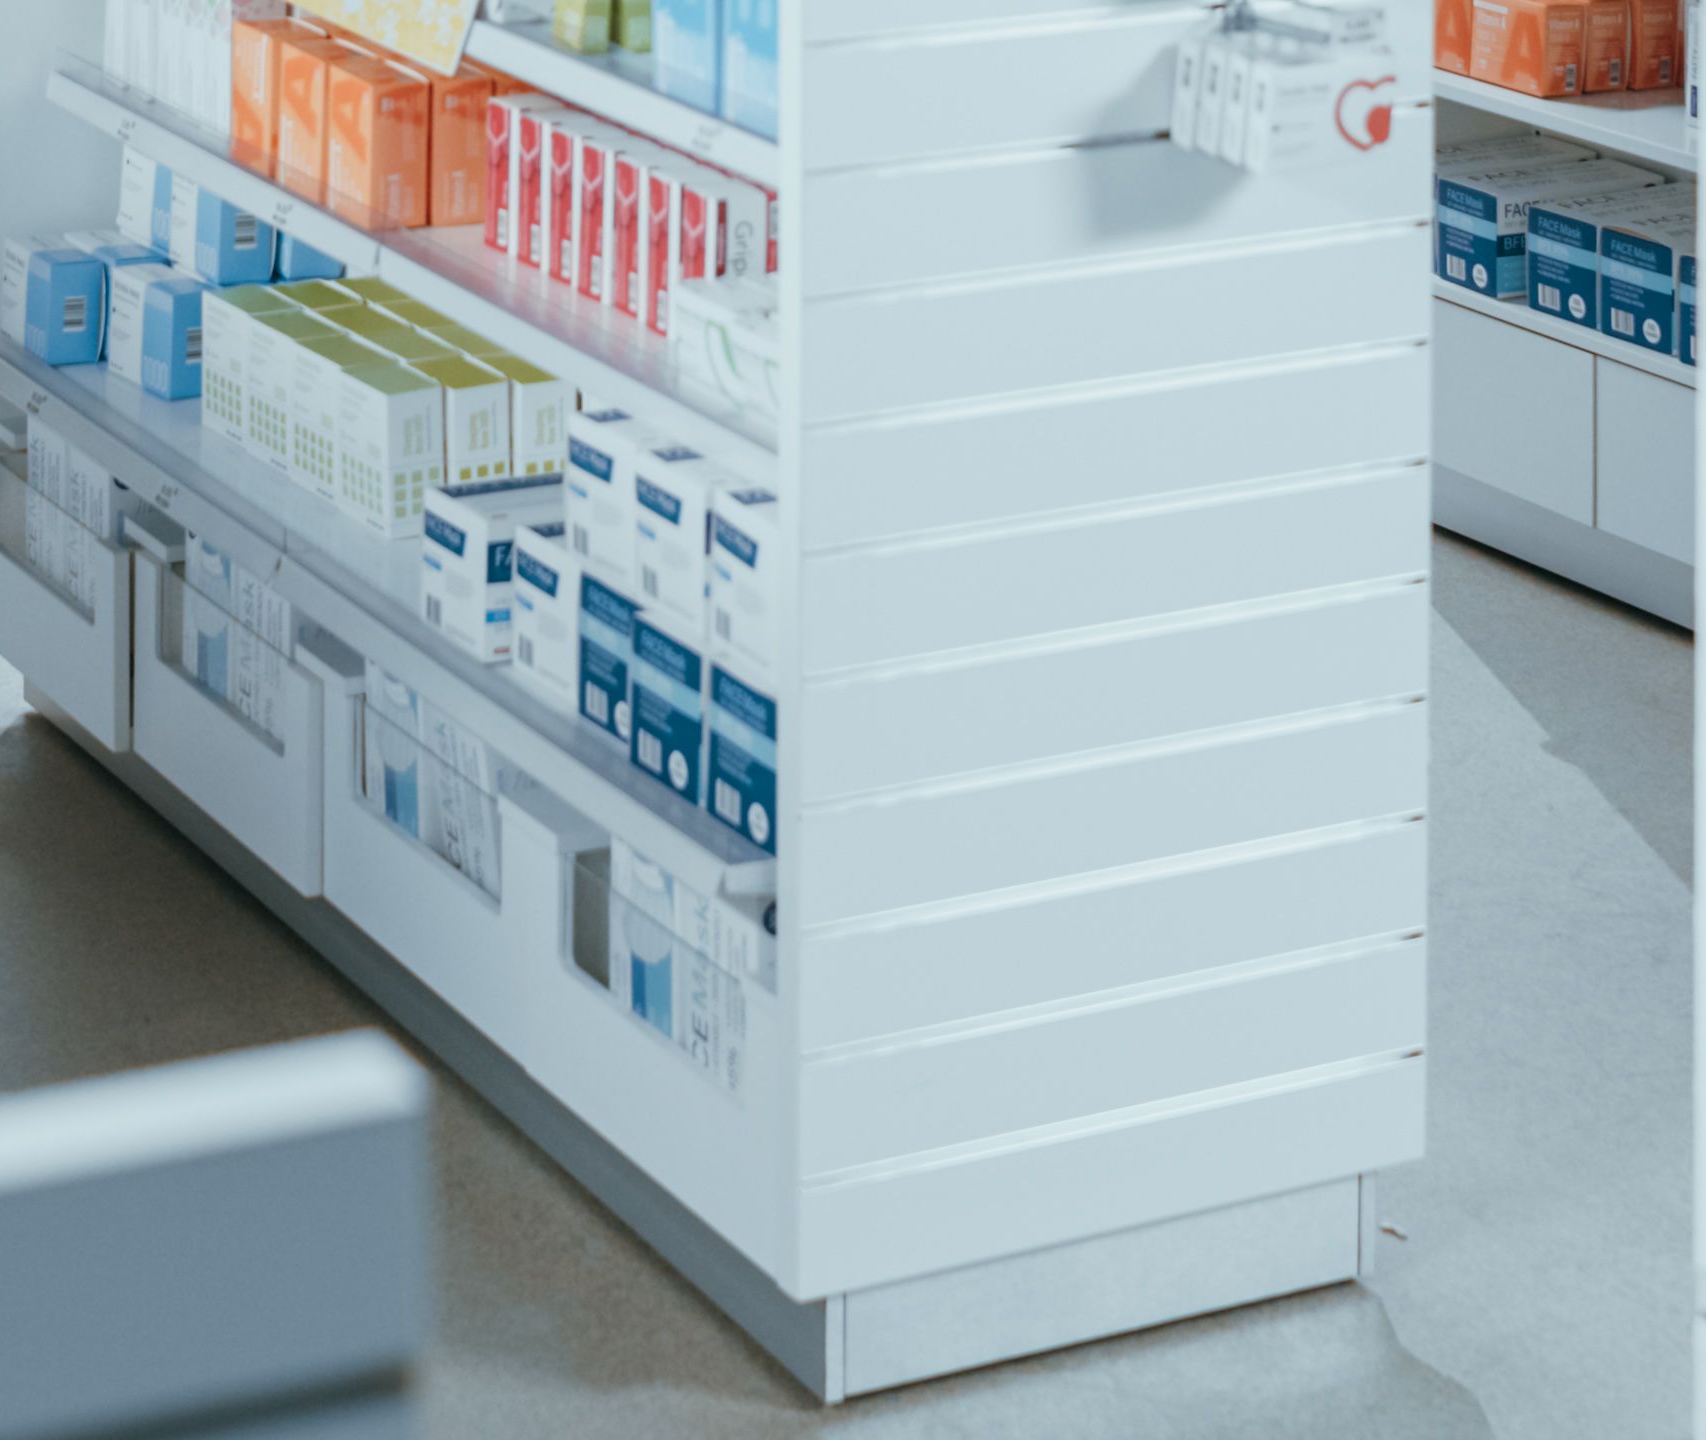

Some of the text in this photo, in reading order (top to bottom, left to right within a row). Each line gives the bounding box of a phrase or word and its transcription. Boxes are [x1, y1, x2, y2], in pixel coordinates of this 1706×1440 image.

[1446, 188, 1484, 210] FACE Mask
[1537, 216, 1581, 238] FACE Mask
[1610, 239, 1656, 262] FACE Mask
